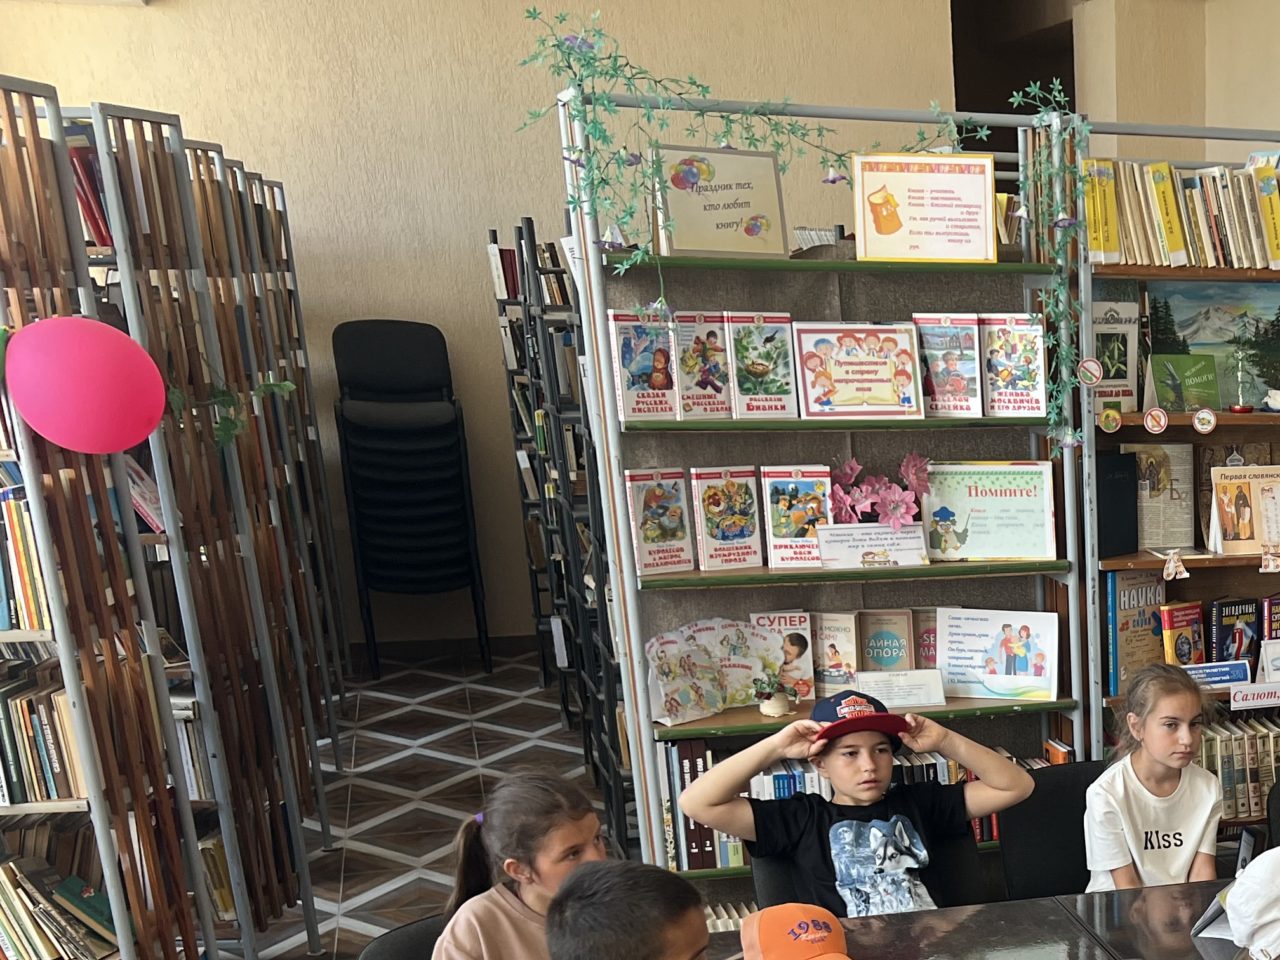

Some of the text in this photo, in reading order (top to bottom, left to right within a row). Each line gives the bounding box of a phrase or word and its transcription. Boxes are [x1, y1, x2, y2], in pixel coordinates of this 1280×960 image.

[690, 181, 754, 196] Праздник тех,
[703, 197, 751, 212] кто любит
[715, 217, 744, 232] книгу!
[851, 368, 880, 376] страну
[636, 391, 666, 399] СКАЗКИ
[681, 393, 718, 401] СМЕШНЫЕ
[631, 405, 674, 414] ПИСАТЕЛЕЙ
[746, 403, 786, 412] Бианки
[929, 403, 972, 411] СЕМЕЙКА
[1220, 471, 1247, 481] Первая
[967, 484, 1038, 498] Помните!
[713, 545, 752, 553] ВОЛШЕБНИК
[720, 557, 747, 565] ГОРОДА
[1119, 584, 1164, 611] НАУКА
[1222, 603, 1256, 617] ЗАГАДОЧНЫЕ
[756, 615, 807, 628] СУПЕР
[865, 638, 907, 648] ТАЙНАЯ
[864, 647, 908, 658] ОПОРА
[1232, 689, 1280, 703] Салют,
[787, 918, 833, 941] 1988
